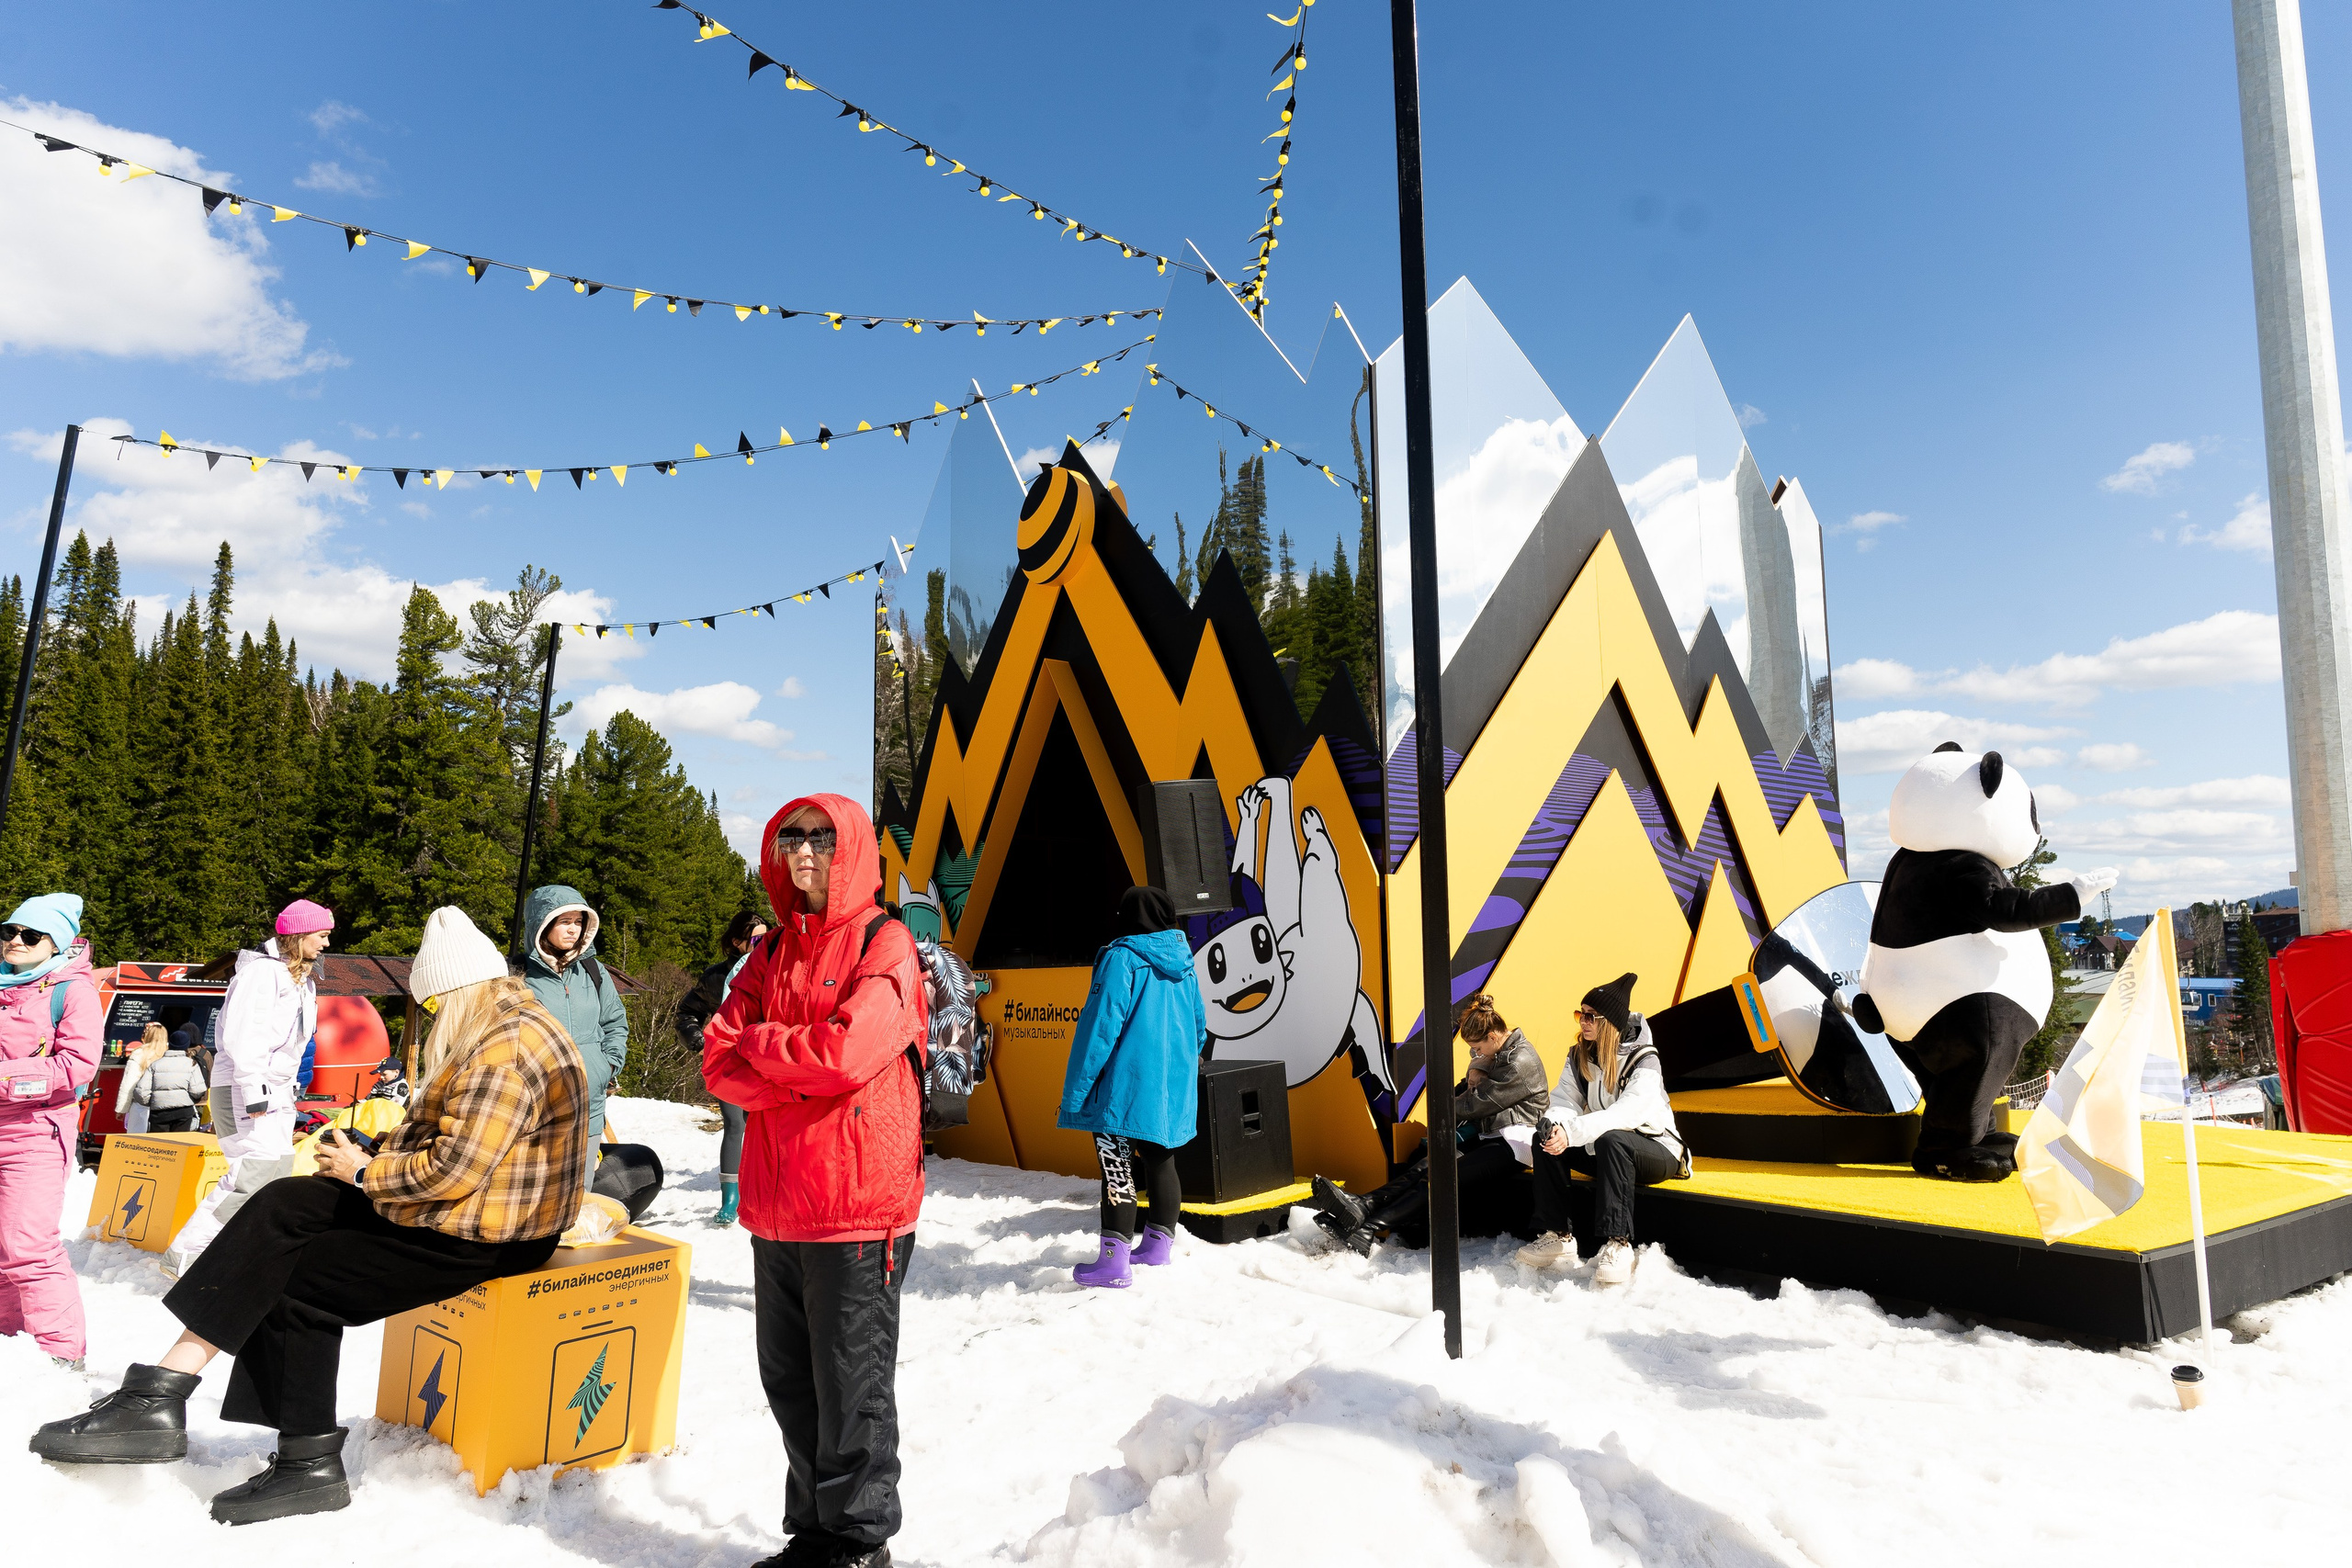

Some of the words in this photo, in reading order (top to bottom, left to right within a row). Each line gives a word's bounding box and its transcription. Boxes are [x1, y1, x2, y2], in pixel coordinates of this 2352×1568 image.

[1004, 999, 1084, 1022] #билайнсо
[1003, 1027, 1066, 1042] музыкальных
[114, 1140, 178, 1156] #билайнсоединяет
[1096, 1133, 1133, 1207] FREEDO
[527, 1258, 671, 1299] #билайнсоединяет
[608, 1272, 670, 1293] энергичных
